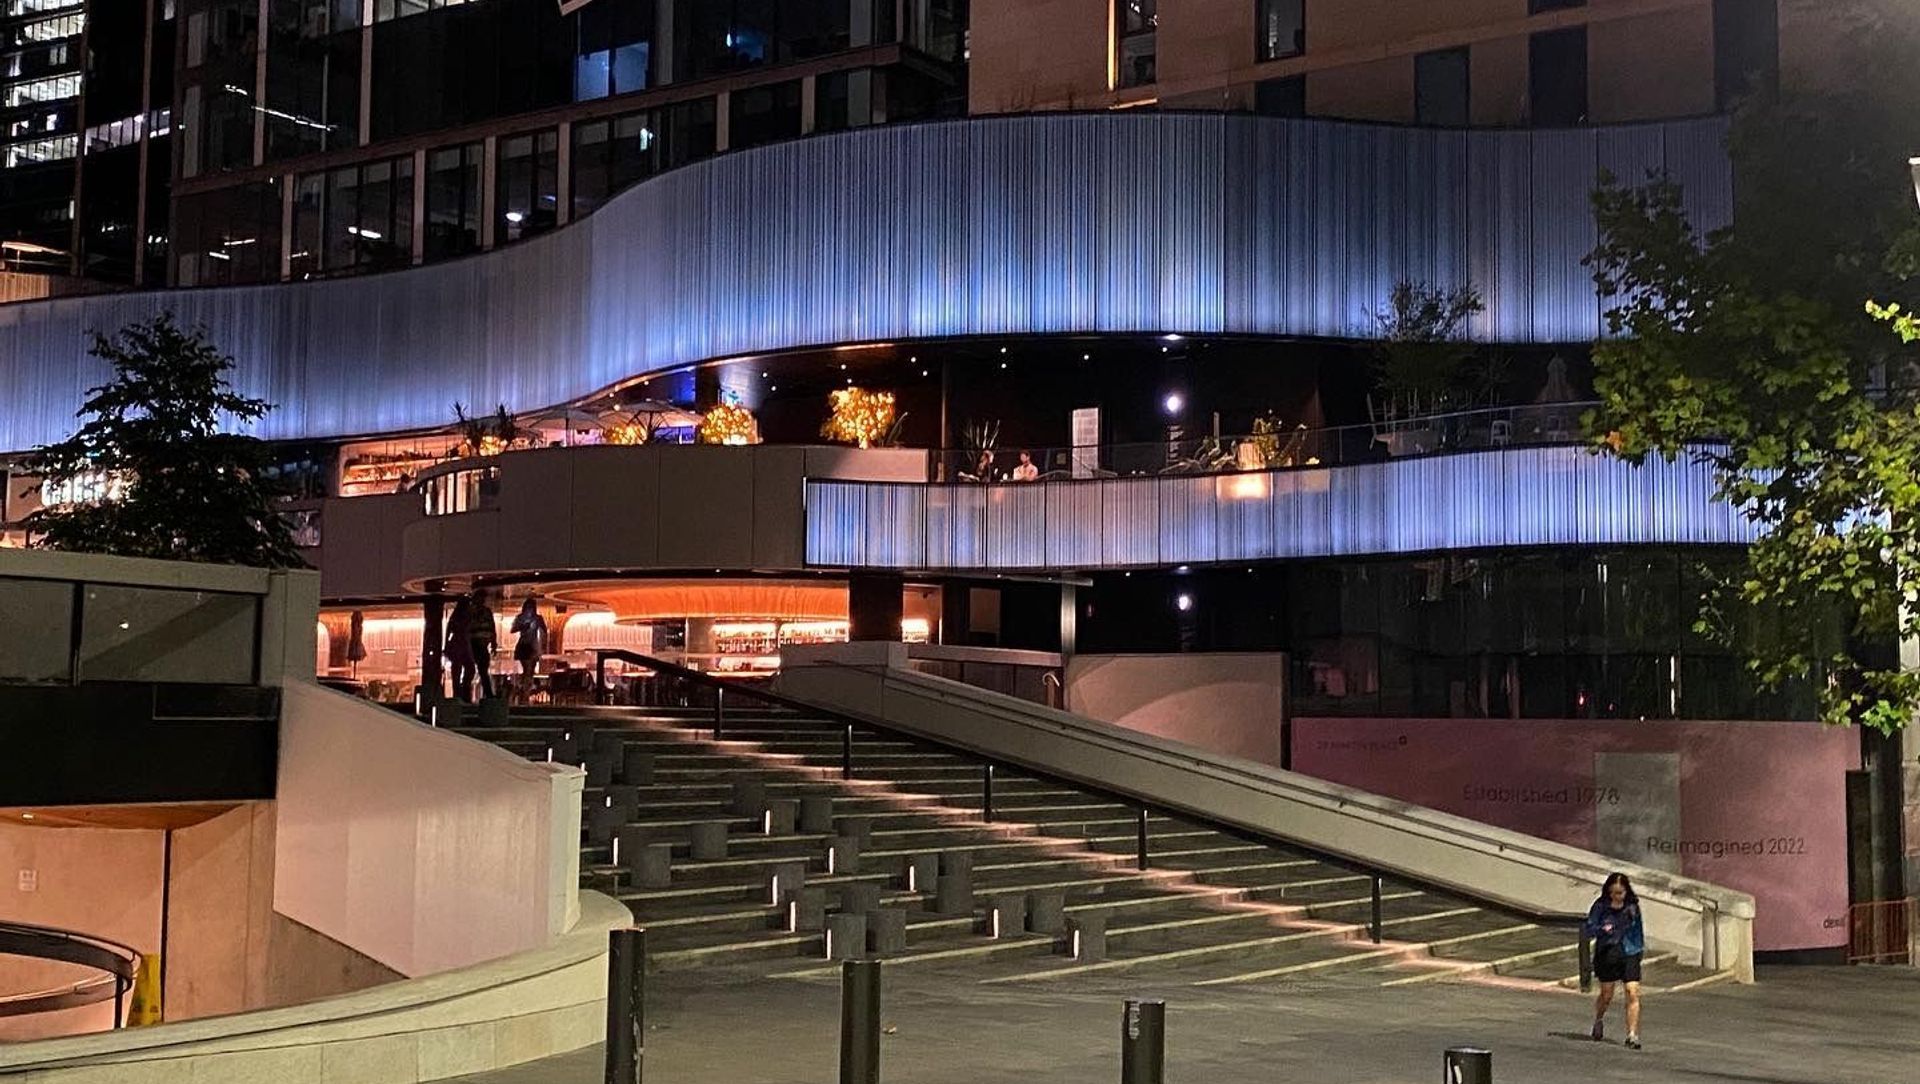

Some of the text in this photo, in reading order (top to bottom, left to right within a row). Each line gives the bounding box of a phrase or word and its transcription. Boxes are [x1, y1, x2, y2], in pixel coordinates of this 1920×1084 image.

[1463, 784, 1621, 805] Established 1978
[1647, 836, 1806, 859] Reimagined 2022
